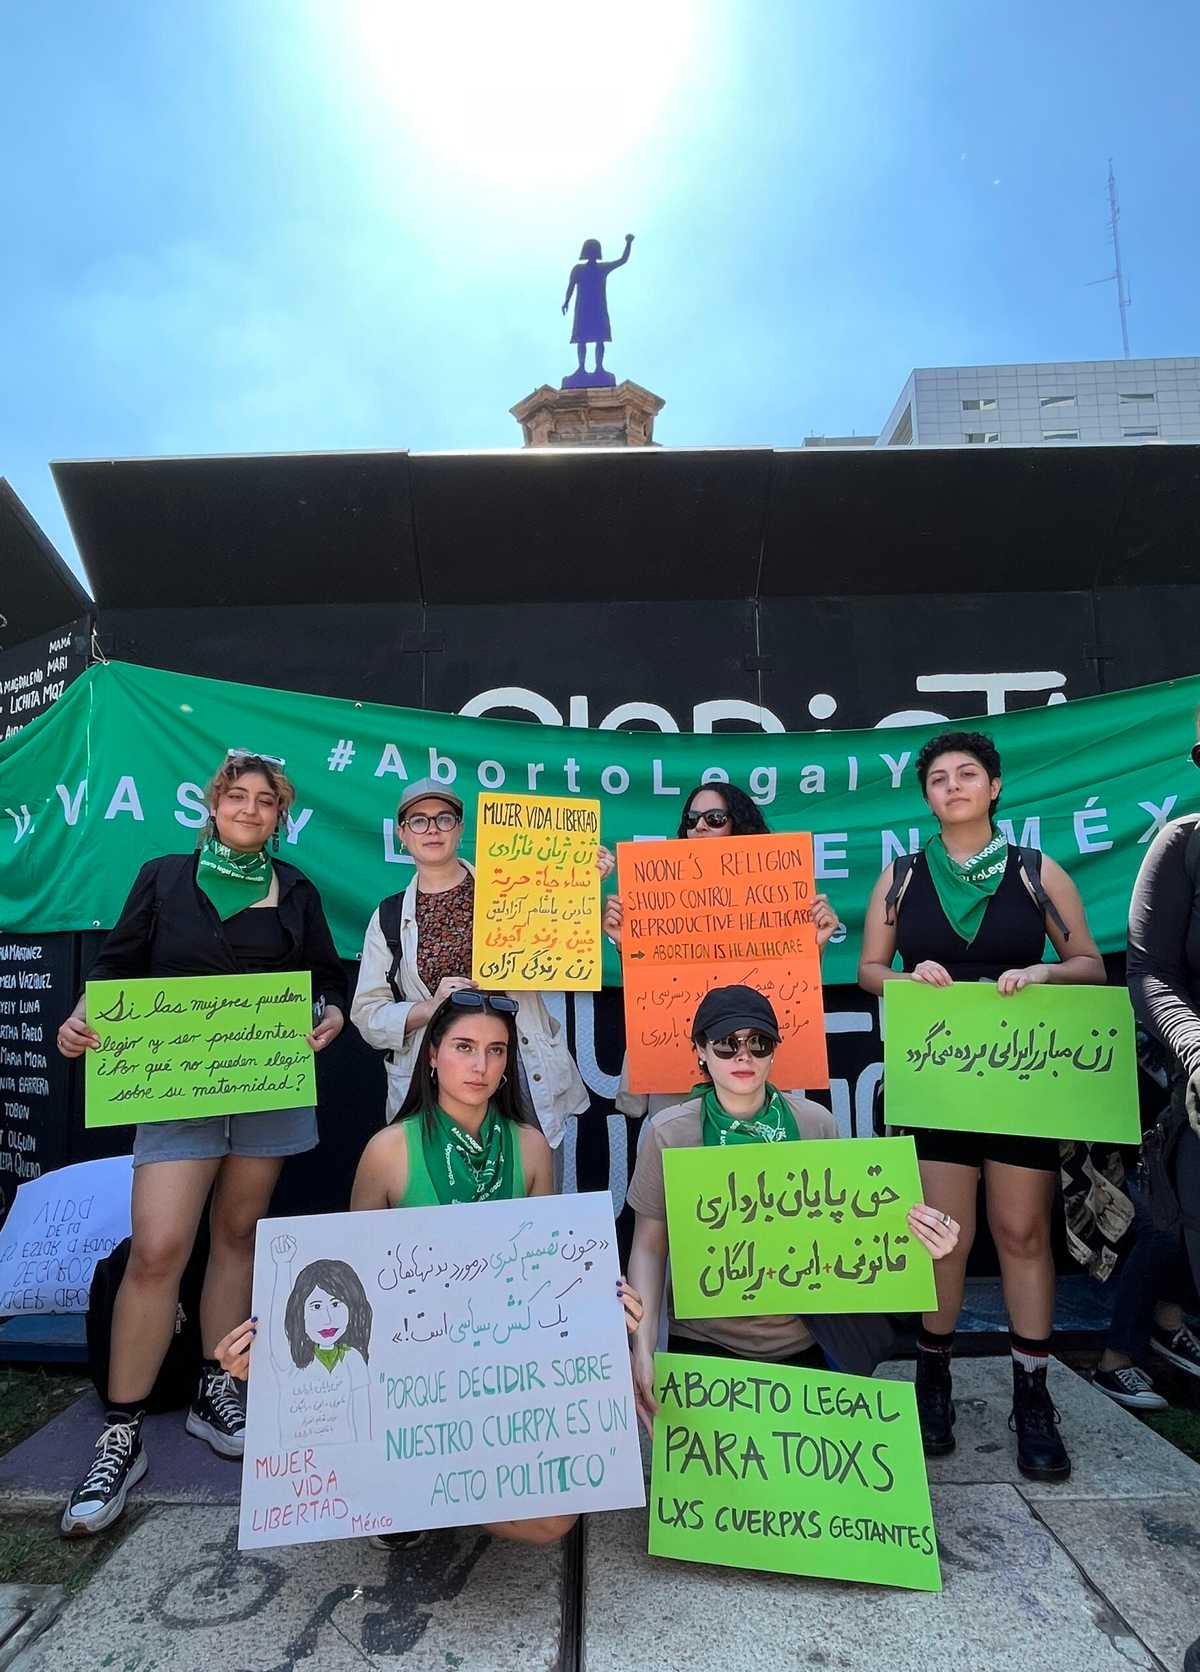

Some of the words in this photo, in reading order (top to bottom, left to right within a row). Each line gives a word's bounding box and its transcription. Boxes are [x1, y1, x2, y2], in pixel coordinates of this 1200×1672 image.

[47, 655, 68, 677] MARI
[484, 802, 523, 828] MUJER
[526, 806, 552, 830] VIDA
[556, 808, 598, 833] LIBERTAD
[721, 849, 802, 877] RELIGION
[680, 886, 740, 909] CONTROL
[746, 885, 789, 907] ACCESS
[793, 881, 809, 899] TO
[630, 913, 736, 938] REPRODUCTIVE
[653, 943, 710, 960] ABORTION
[714, 944, 726, 959] IS
[728, 938, 804, 959] HEALTHCARE
[20, 1000, 41, 1014] LUNA
[95, 990, 141, 1021] Si
[144, 990, 187, 1018] las
[190, 996, 252, 1020] mujeres
[255, 987, 307, 1014] pueden
[25, 1051, 47, 1069] MORA
[95, 1036, 144, 1058] elegir
[168, 1032, 201, 1045] ser
[1072, 1027, 1118, 1073] زن
[145, 1058, 172, 1082] qué
[180, 1060, 202, 1073] no
[203, 1053, 258, 1077] pueden
[264, 1050, 311, 1071] elegir
[108, 1084, 154, 1102] sobre
[158, 1085, 186, 1100] su
[696, 1169, 776, 1230] بارداری
[776, 1167, 848, 1224] پایان
[850, 1164, 901, 1218] حق
[458, 1361, 547, 1401] DECIDIR
[551, 1353, 612, 1388] SOBRE
[660, 1370, 792, 1414] ABORTO
[802, 1383, 901, 1423] LEGAL
[385, 1421, 473, 1462] NUESTRO
[482, 1405, 560, 1448] CUERPX
[566, 1399, 592, 1436] ES
[597, 1396, 628, 1434] UN
[255, 1448, 317, 1480] MUJER
[665, 1424, 769, 1481] PARA
[772, 1430, 895, 1492] TODXS
[291, 1469, 338, 1499] VIDA
[429, 1469, 487, 1506] ACTO
[251, 1497, 350, 1532] LIBERTAD
[351, 1504, 394, 1534] México
[657, 1497, 705, 1530] LXS
[715, 1507, 822, 1539] CUERPXS
[829, 1515, 935, 1556] GESTANTES
